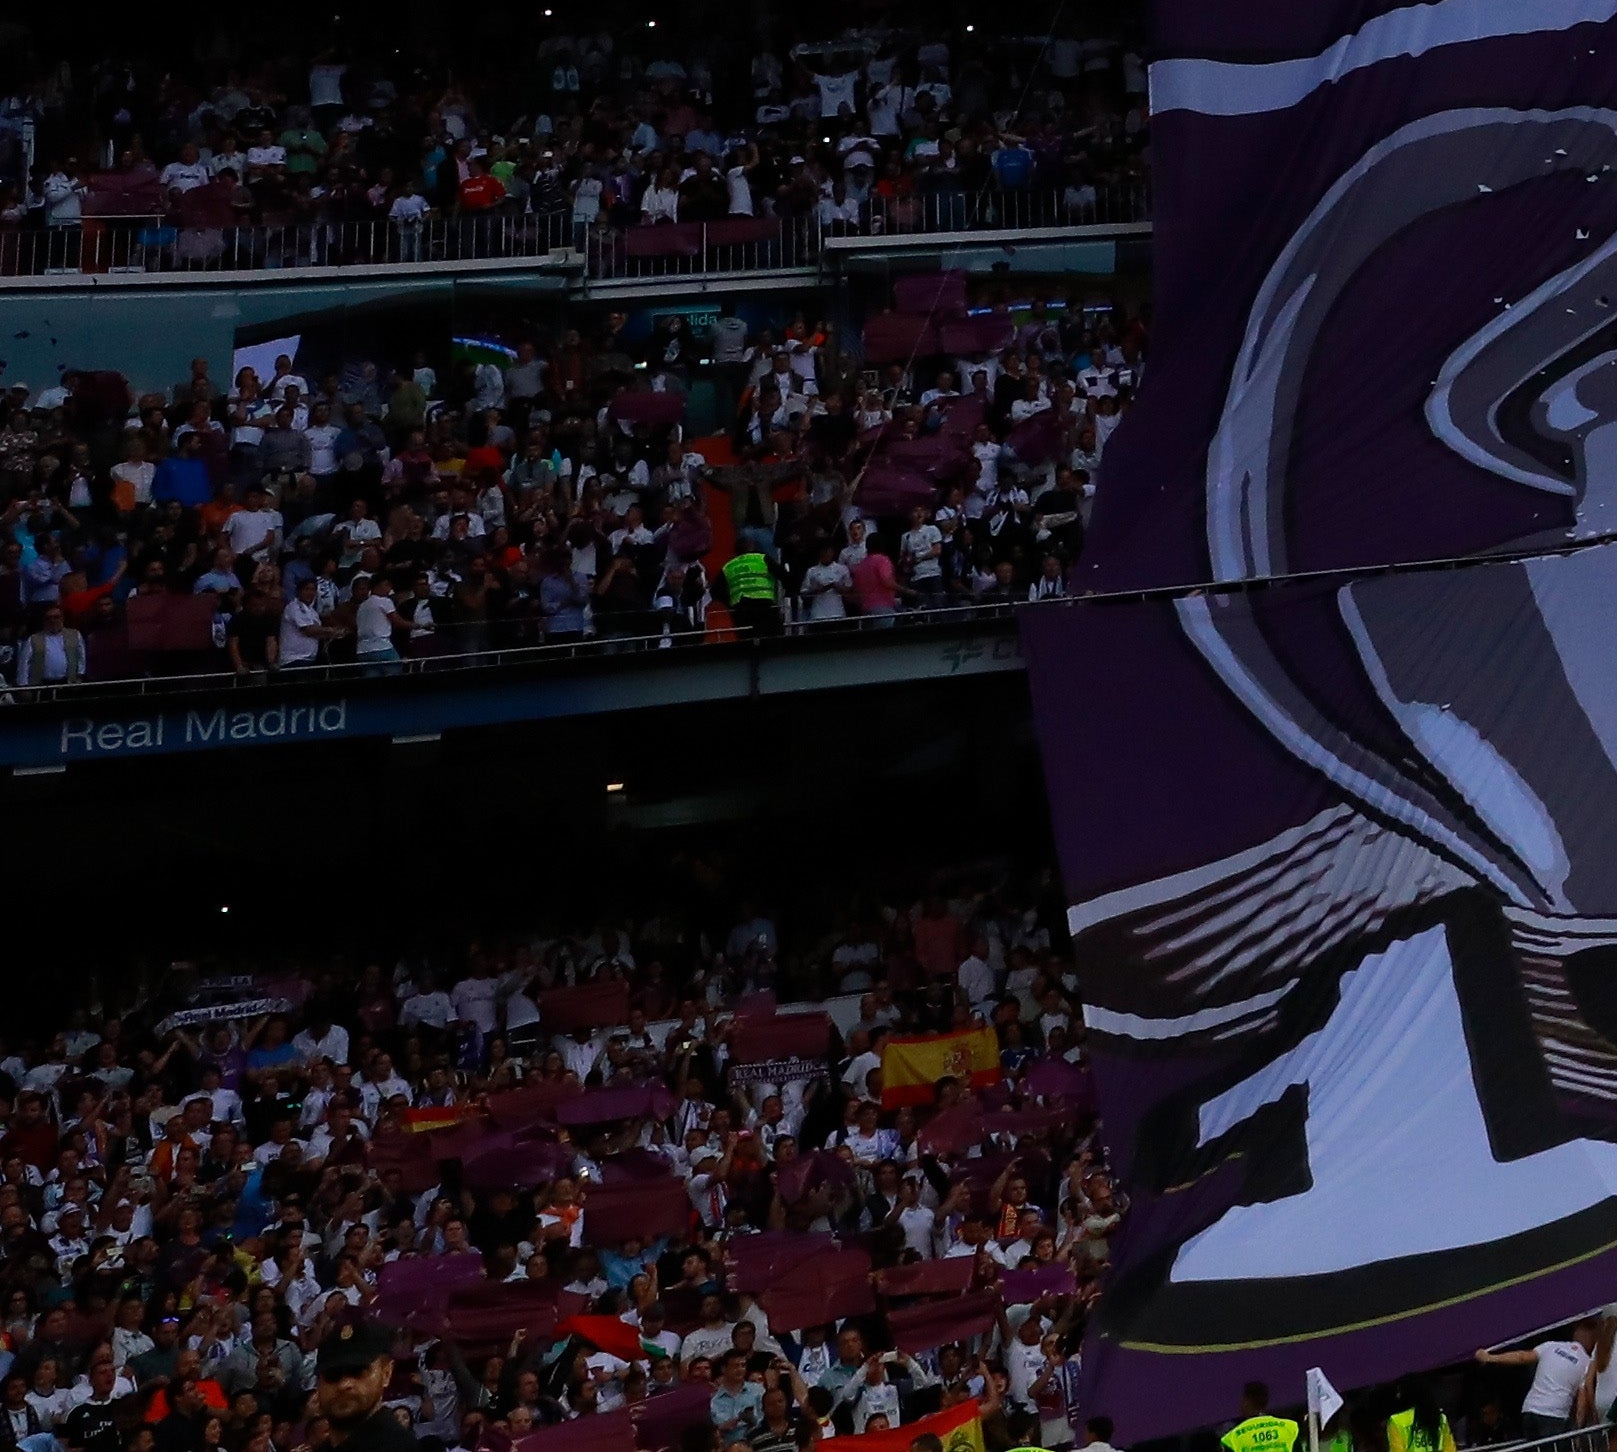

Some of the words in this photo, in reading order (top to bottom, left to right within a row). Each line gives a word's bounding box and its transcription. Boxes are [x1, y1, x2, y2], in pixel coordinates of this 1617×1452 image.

[61, 716, 163, 753] Real
[185, 699, 348, 742] Madrid
[767, 1061, 814, 1077] MADRID
[1252, 1429, 1279, 1443] 1063
